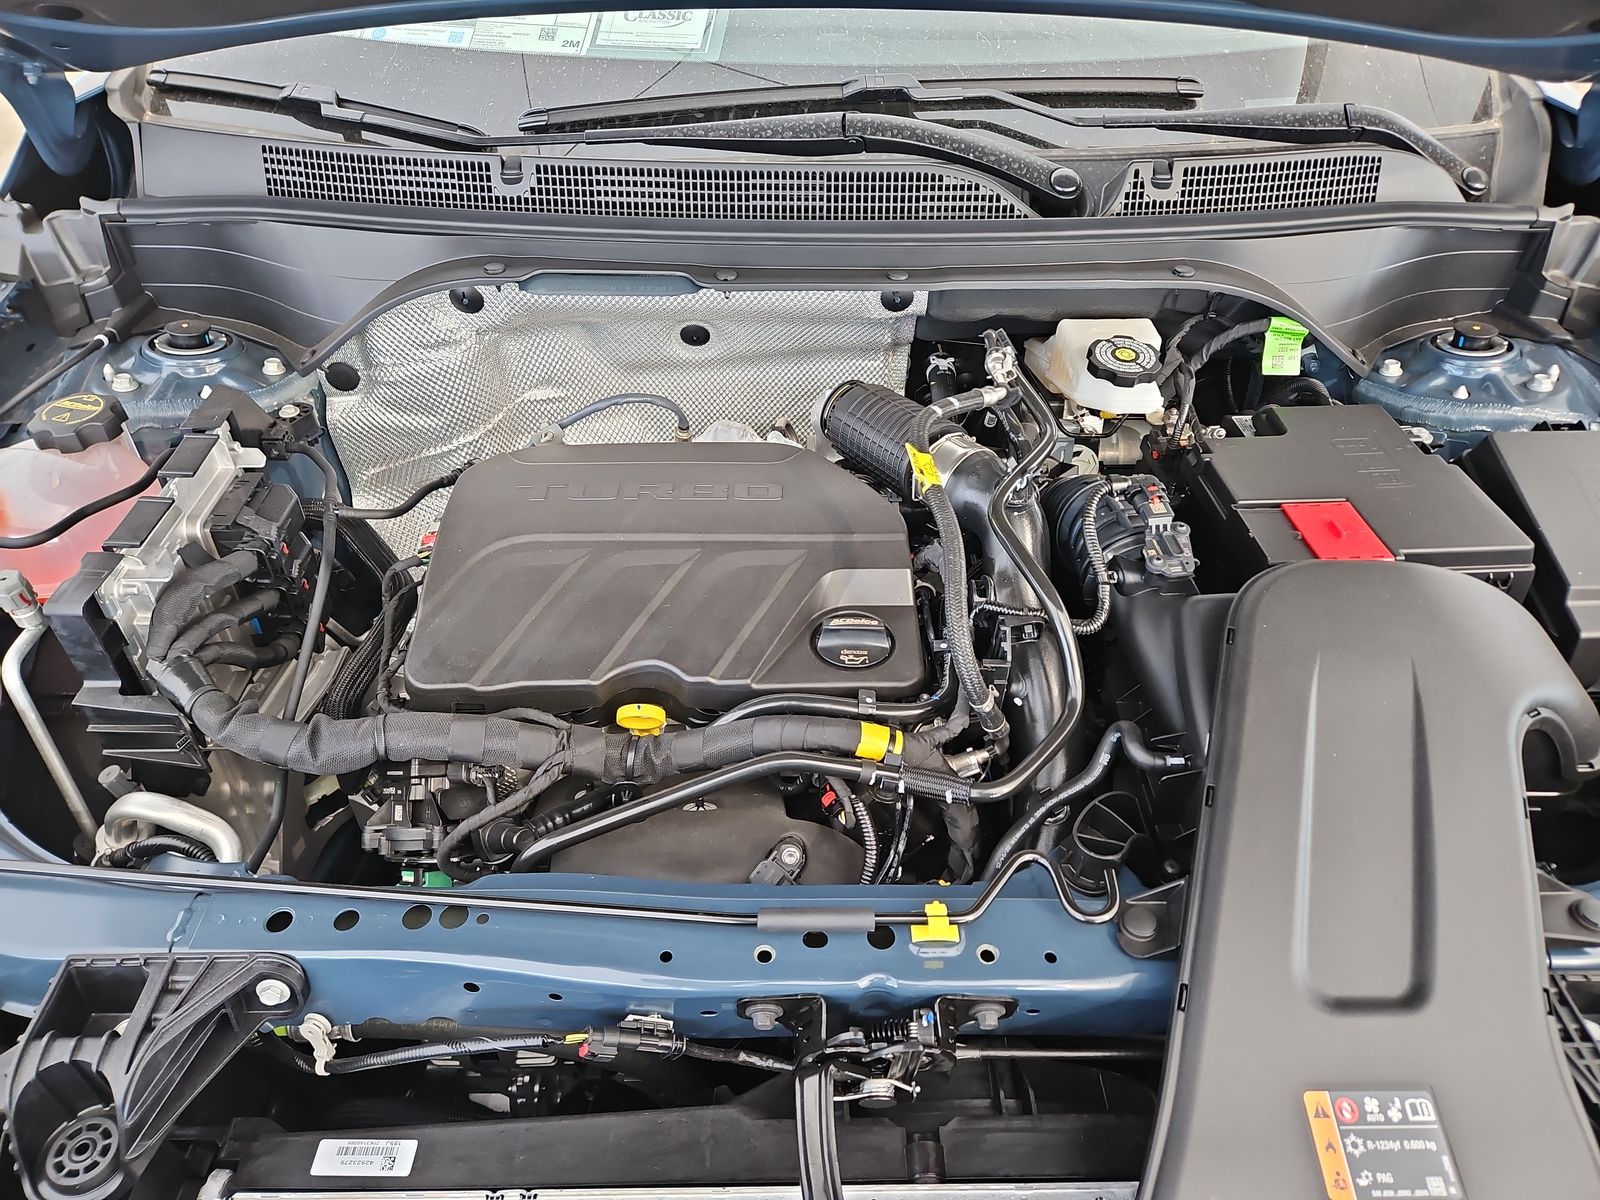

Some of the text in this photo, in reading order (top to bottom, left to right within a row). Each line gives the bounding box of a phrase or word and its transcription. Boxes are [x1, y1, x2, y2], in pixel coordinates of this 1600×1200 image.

[624, 11, 692, 22] CLASSIC
[561, 40, 580, 48] 2M
[515, 482, 783, 501] TURBO
[828, 618, 879, 626] ACDelco
[1375, 1172, 1394, 1183] PAG
